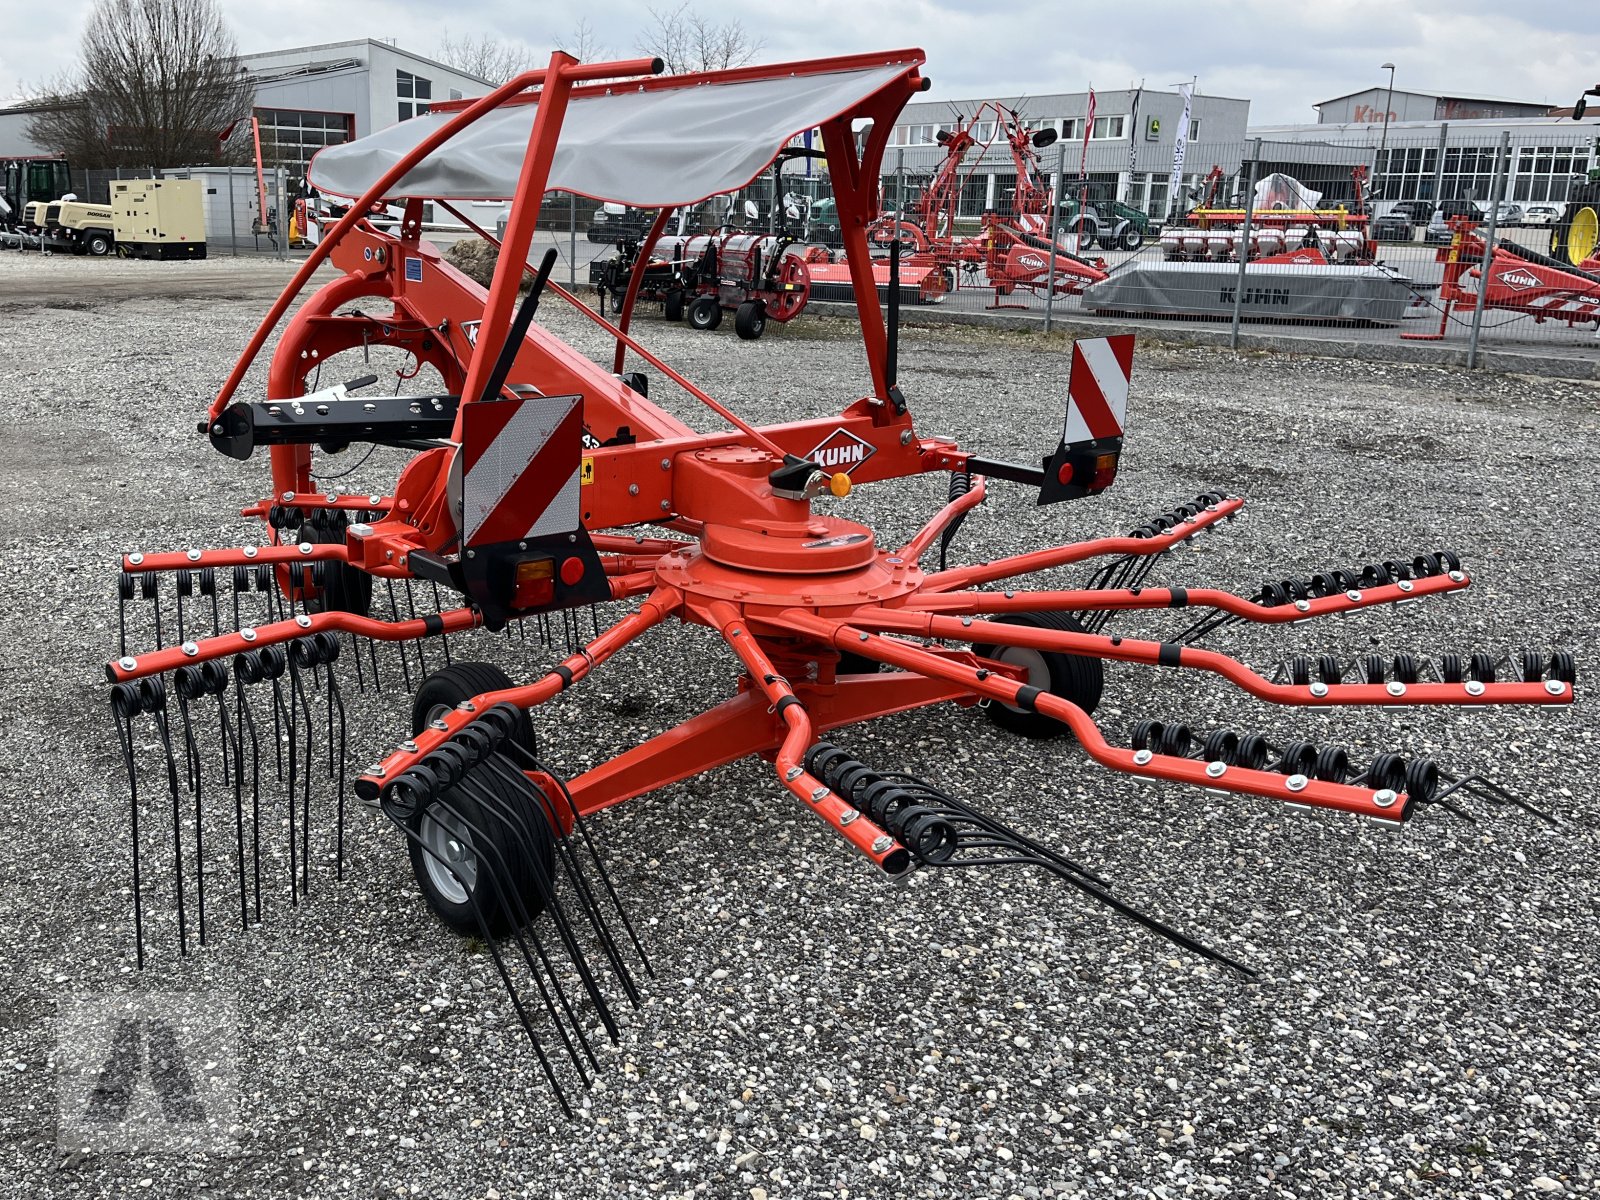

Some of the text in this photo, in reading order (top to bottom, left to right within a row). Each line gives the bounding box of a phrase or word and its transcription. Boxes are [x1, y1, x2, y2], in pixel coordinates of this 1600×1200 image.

[1020, 256, 1043, 268] KUHN
[1503, 273, 1537, 287] KUHN
[814, 444, 864, 467] KUHN
